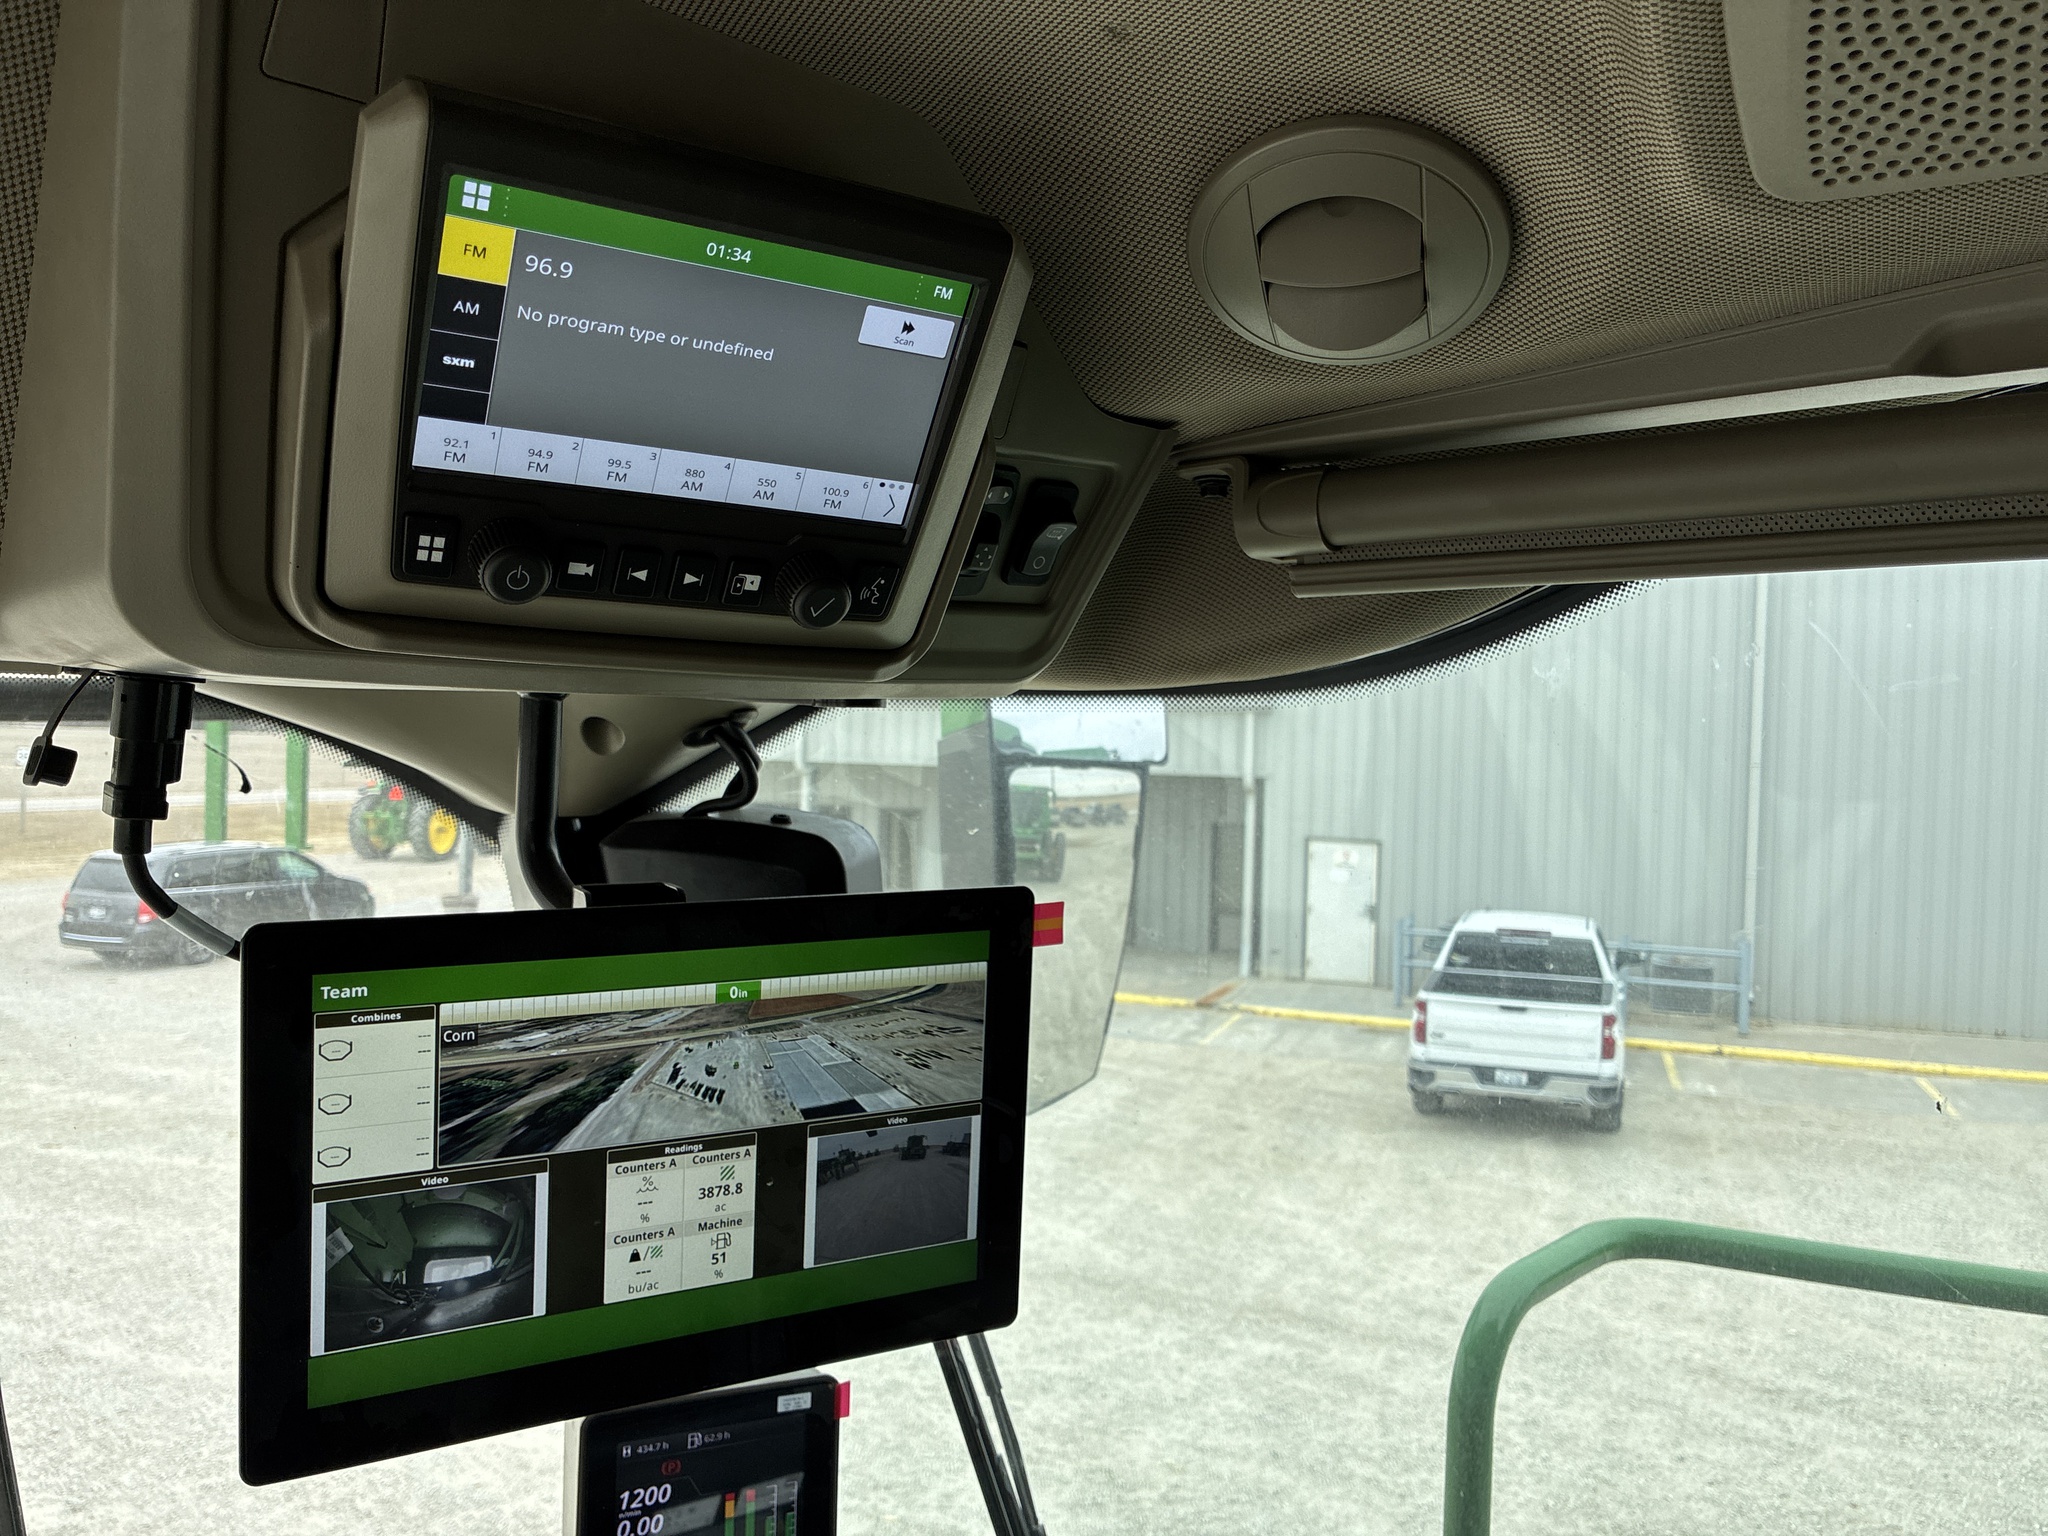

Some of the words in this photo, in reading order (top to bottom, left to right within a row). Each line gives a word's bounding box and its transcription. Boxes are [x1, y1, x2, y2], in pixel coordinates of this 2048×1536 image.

[463, 243, 487, 259] FM
[706, 242, 752, 264] 01:34
[525, 254, 574, 279] 96.9
[933, 285, 953, 300] FM
[452, 300, 480, 316] AM
[517, 305, 543, 322] No
[547, 312, 624, 336] program
[629, 325, 666, 346] type
[670, 333, 689, 347] or
[692, 337, 774, 361] undefined
[893, 336, 915, 347] Scan
[442, 355, 476, 369] sxm
[491, 431, 496, 440] 1
[443, 437, 469, 449] 92.1
[571, 442, 580, 451] 2
[443, 451, 467, 463] FM
[527, 448, 554, 460] 94.9
[650, 452, 657, 461] 3
[527, 461, 549, 474] FM
[607, 458, 632, 469] 99.5
[724, 462, 731, 470] 4
[606, 471, 627, 483] FM
[684, 468, 706, 479] 880
[795, 472, 802, 480] 5
[680, 480, 704, 492] AM
[757, 477, 777, 488] 550
[862, 481, 869, 490] 6
[752, 489, 775, 501] AM
[822, 486, 850, 498] 100.9
[823, 498, 842, 510] FM
[320, 984, 368, 1000] Team
[350, 1011, 402, 1024] Combines
[443, 1028, 476, 1043] Corn
[886, 1116, 908, 1126] Video
[664, 1143, 703, 1155] Readings
[692, 1149, 741, 1165] Counters
[743, 1148, 751, 1158] A
[615, 1159, 666, 1175] Counters
[668, 1158, 677, 1168] A
[421, 1175, 449, 1187] Video
[698, 1182, 743, 1200] 3878.8
[714, 1203, 727, 1213] ac
[640, 1213, 650, 1224] %
[697, 1217, 743, 1232] Machine
[613, 1228, 665, 1245] Counters
[667, 1227, 675, 1237] A
[711, 1251, 727, 1266] 51
[713, 1268, 724, 1279] %
[627, 1281, 659, 1295] bu/ac
[619, 1483, 672, 1511] 1200
[616, 1513, 664, 1536] 0.00
